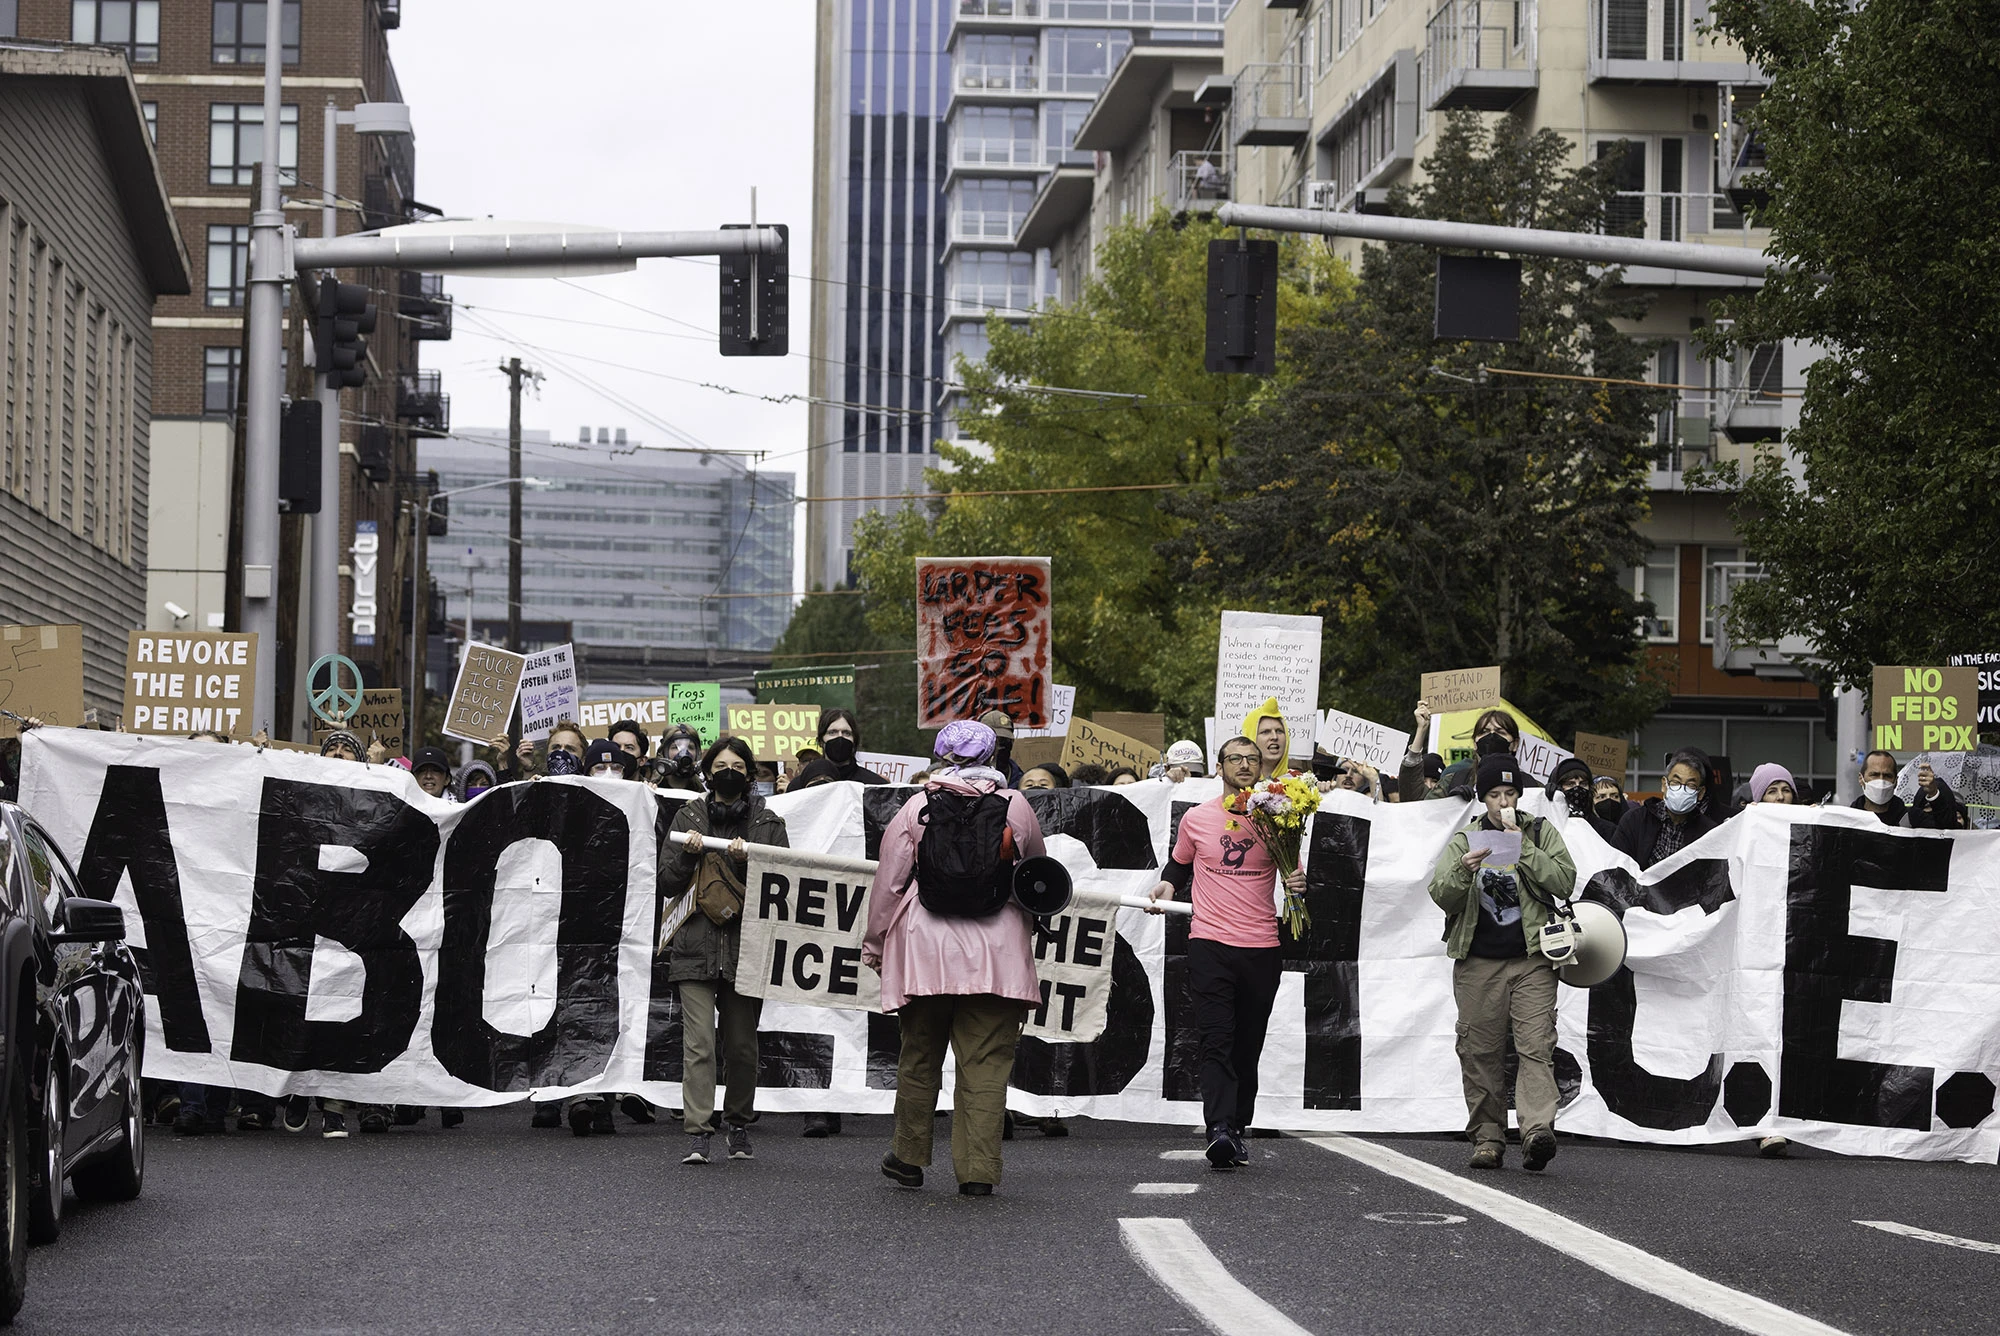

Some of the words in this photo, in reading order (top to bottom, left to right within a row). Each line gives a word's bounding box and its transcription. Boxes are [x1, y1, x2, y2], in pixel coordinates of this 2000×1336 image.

[924, 570, 1041, 603] LARPER
[943, 608, 1027, 648] FEDS
[137, 638, 249, 665] REVOKE
[1264, 639, 1304, 654] foreigner
[476, 651, 514, 675] FUCK
[524, 655, 551, 672] ELEASE
[554, 652, 566, 664] THE
[951, 648, 1007, 678] GO
[1225, 652, 1257, 660] resides
[1263, 654, 1292, 666] among
[1295, 657, 1313, 666] you
[1951, 654, 1962, 667] IN
[1963, 652, 1984, 666] THE
[132, 672, 185, 698] THE
[195, 674, 241, 699] ICE
[468, 672, 505, 692] ICE
[521, 674, 549, 690] EPSTEIN
[758, 675, 854, 690] UNPRESIDENTED
[1222, 671, 1256, 680] mistreat
[1286, 676, 1302, 685] The
[1224, 680, 1258, 691] foreigner
[1260, 684, 1286, 694] among
[1290, 687, 1306, 696] you
[1428, 675, 1439, 690] I
[1444, 672, 1483, 688] STAND
[1904, 668, 1943, 693] NO
[363, 692, 394, 706] What
[460, 688, 504, 715] FUCK
[670, 684, 705, 702] Frogs
[927, 677, 1040, 725] HOME!
[1224, 691, 1244, 699] must
[1248, 692, 1257, 700] be
[1426, 687, 1496, 709] IMMIGRANTS!
[580, 700, 667, 727] REVOKE
[682, 702, 704, 710] NOT
[1220, 710, 1242, 720] Love
[1223, 701, 1242, 710] your
[1890, 696, 1958, 722] FEDS
[133, 705, 241, 732] PERMIT
[455, 707, 495, 730] IOF
[524, 716, 553, 735] ABOLISH
[729, 709, 767, 731] ICE
[773, 710, 820, 732] OUT
[1332, 716, 1385, 745] SHAME
[1876, 724, 1903, 750] IN
[1923, 725, 1974, 751] PDX
[774, 735, 816, 756] PD
[1071, 740, 1084, 758] is
[1334, 737, 1358, 756] ON
[1363, 743, 1390, 764] YOU
[1582, 741, 1596, 752] GOT
[864, 761, 910, 784] FIGHT
[659, 883, 696, 944] PERMIT
[759, 872, 866, 932] REV
[1033, 913, 1107, 967] HE
[770, 939, 862, 995] ICE
